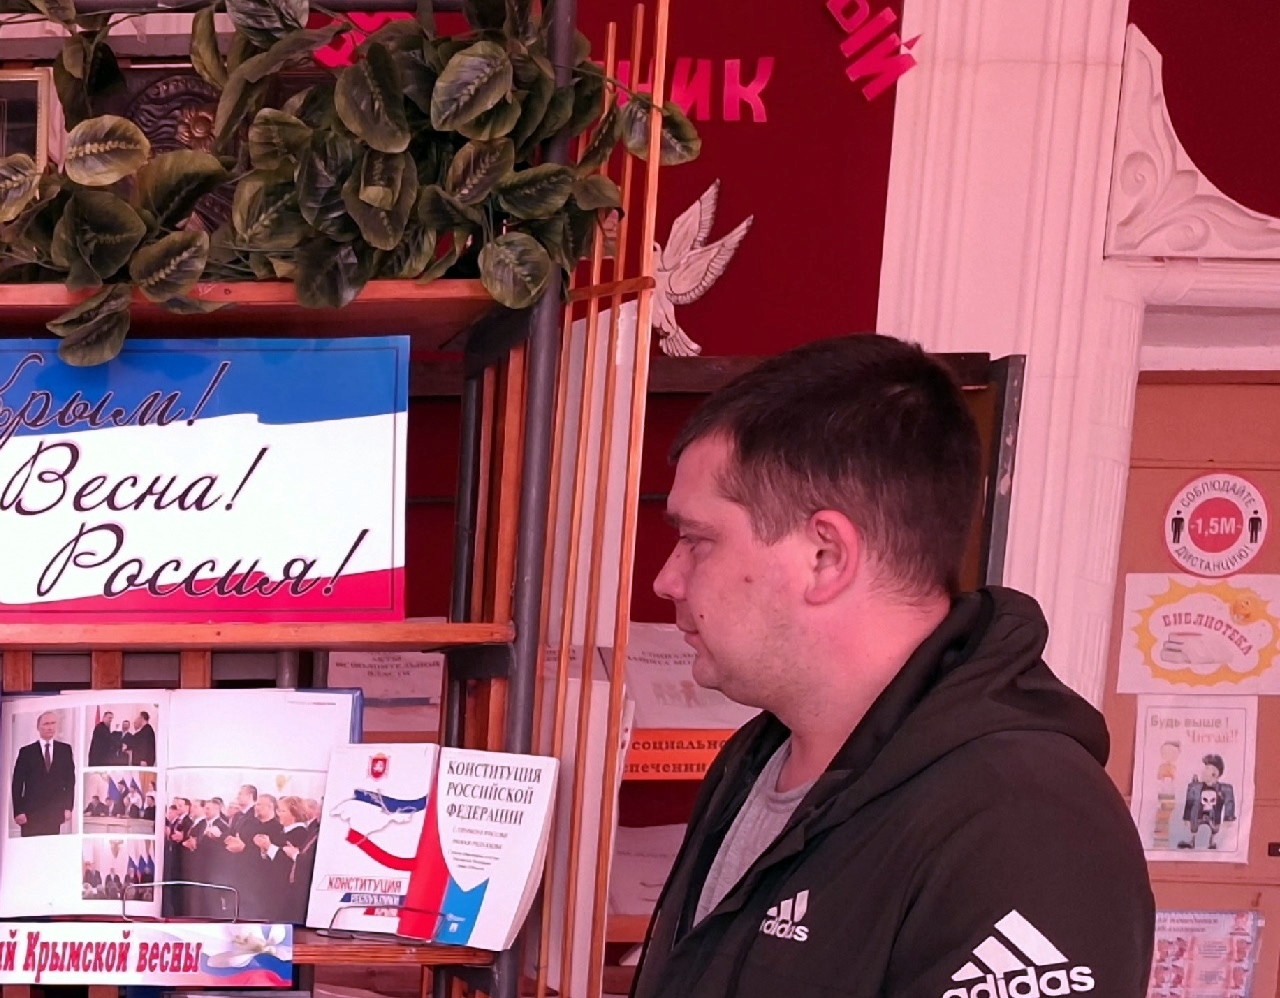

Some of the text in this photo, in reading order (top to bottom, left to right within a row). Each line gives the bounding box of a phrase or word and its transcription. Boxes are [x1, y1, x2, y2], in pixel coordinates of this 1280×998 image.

[0, 440, 269, 515] Весна!
[1181, 479, 1256, 508] СОБЛЮДАЙТЕ
[36, 522, 370, 598] Россия!
[1162, 612, 1253, 656] БИБЛИОТЕКА
[447, 760, 543, 785] КОНСТИТУЦИЯ
[446, 784, 535, 806] РОССИЙСКОЙ
[446, 803, 525, 826] ФЕДЕРАЦИИ
[328, 875, 402, 893] КОНСТИТУЦИЯ
[22, 930, 131, 983] Крымской
[135, 940, 202, 973] весны
